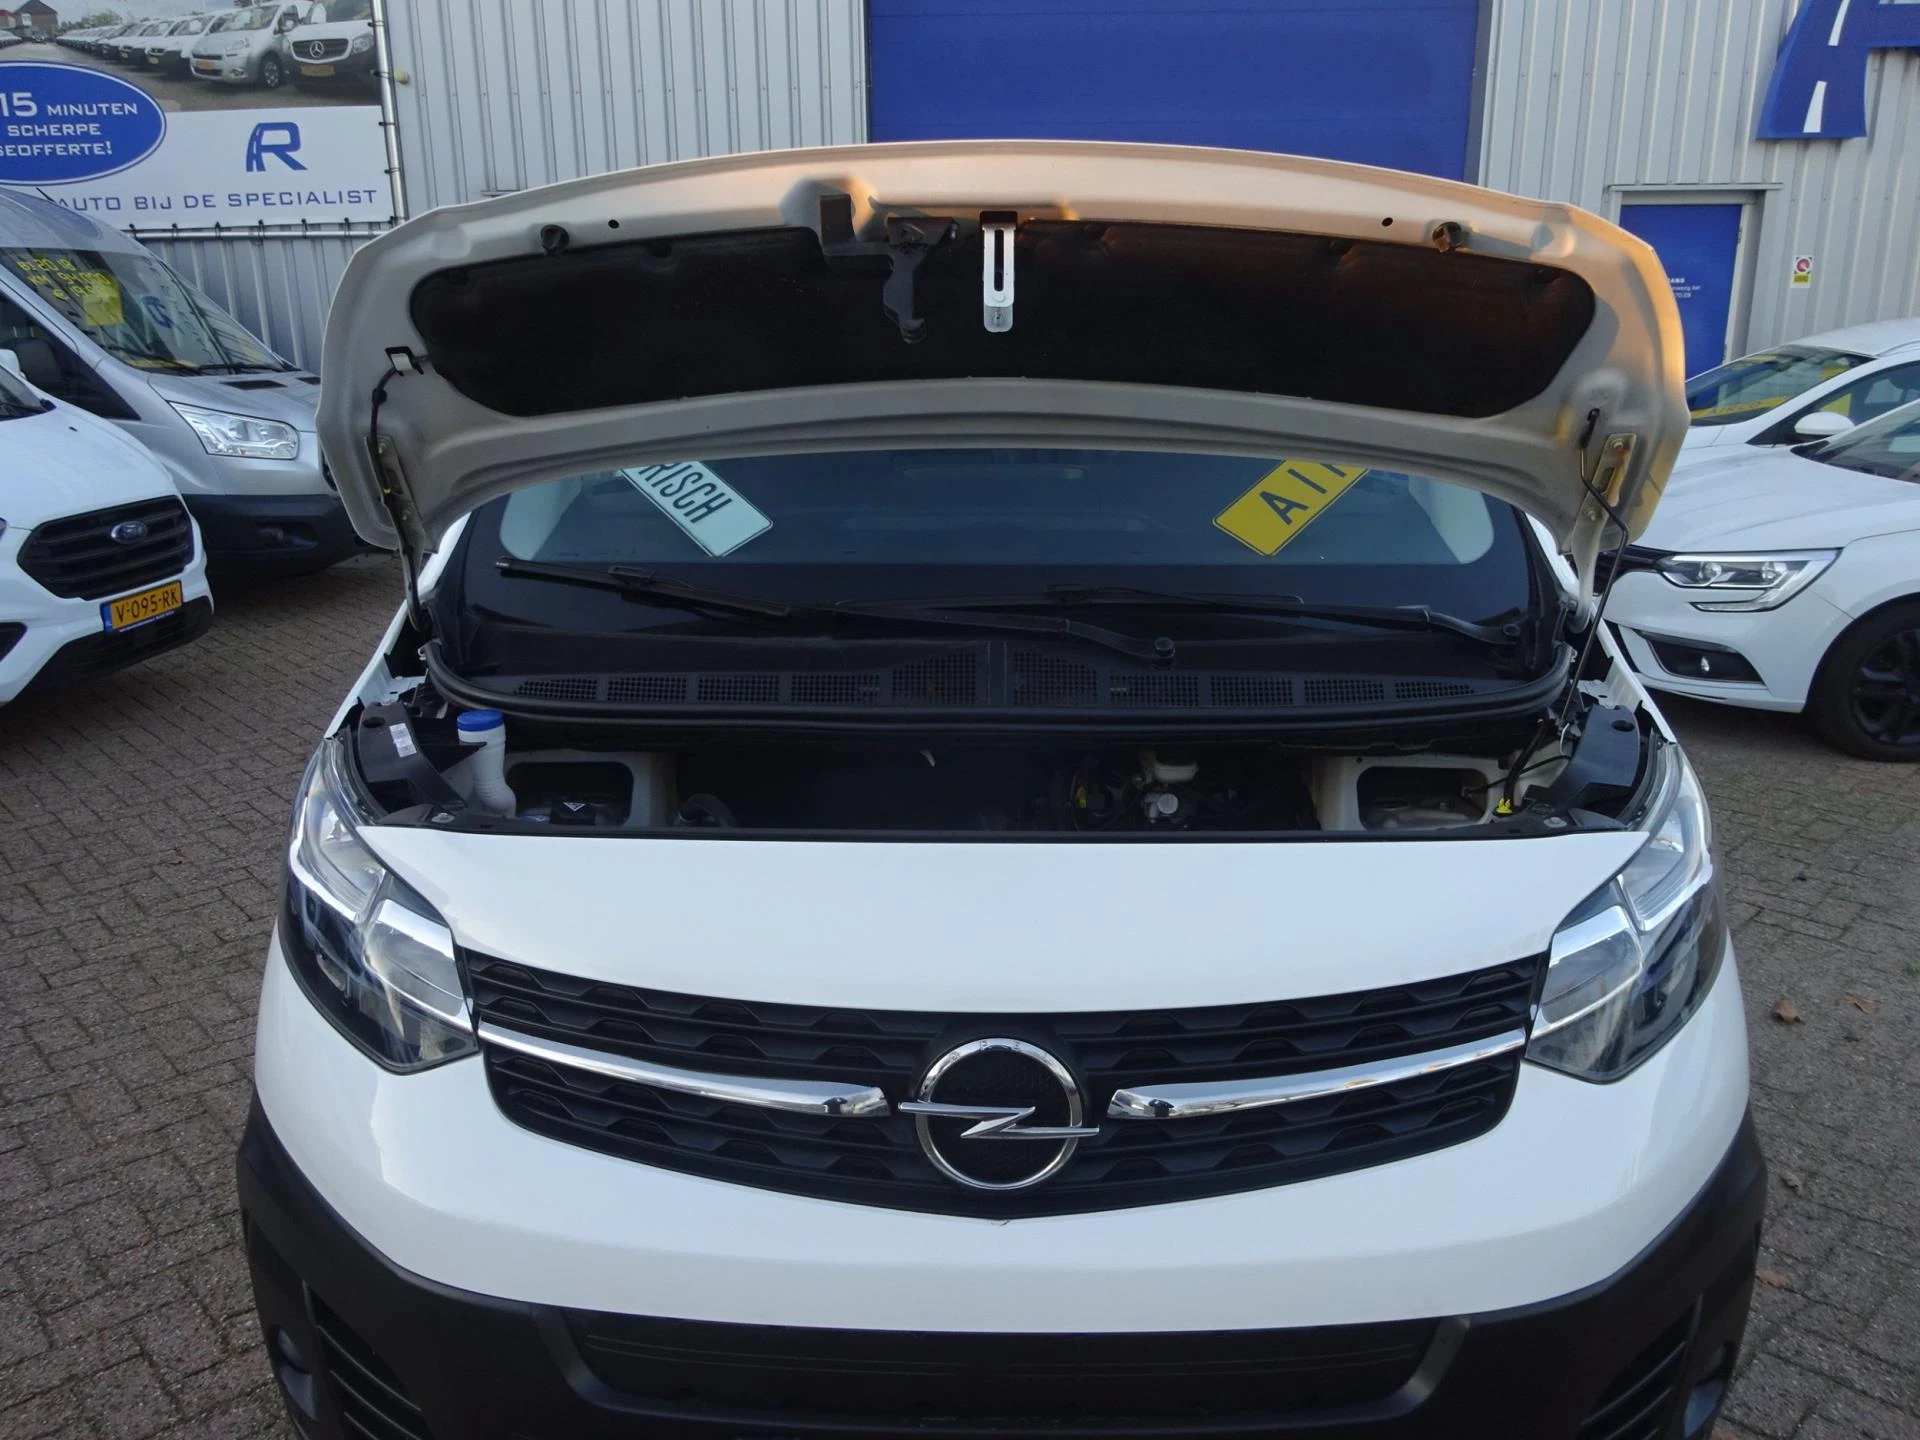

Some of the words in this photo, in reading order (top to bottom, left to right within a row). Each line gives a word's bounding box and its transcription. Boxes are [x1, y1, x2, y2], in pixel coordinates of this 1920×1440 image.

[0, 92, 38, 117] 15
[47, 102, 138, 116] MINUTEN
[7, 123, 102, 137] SCHERPE
[133, 196, 173, 210] BIJ
[184, 194, 217, 209] DE
[227, 189, 377, 208] SPECIALIST
[1259, 462, 1347, 526] AI
[115, 587, 179, 624] V-095-RK
